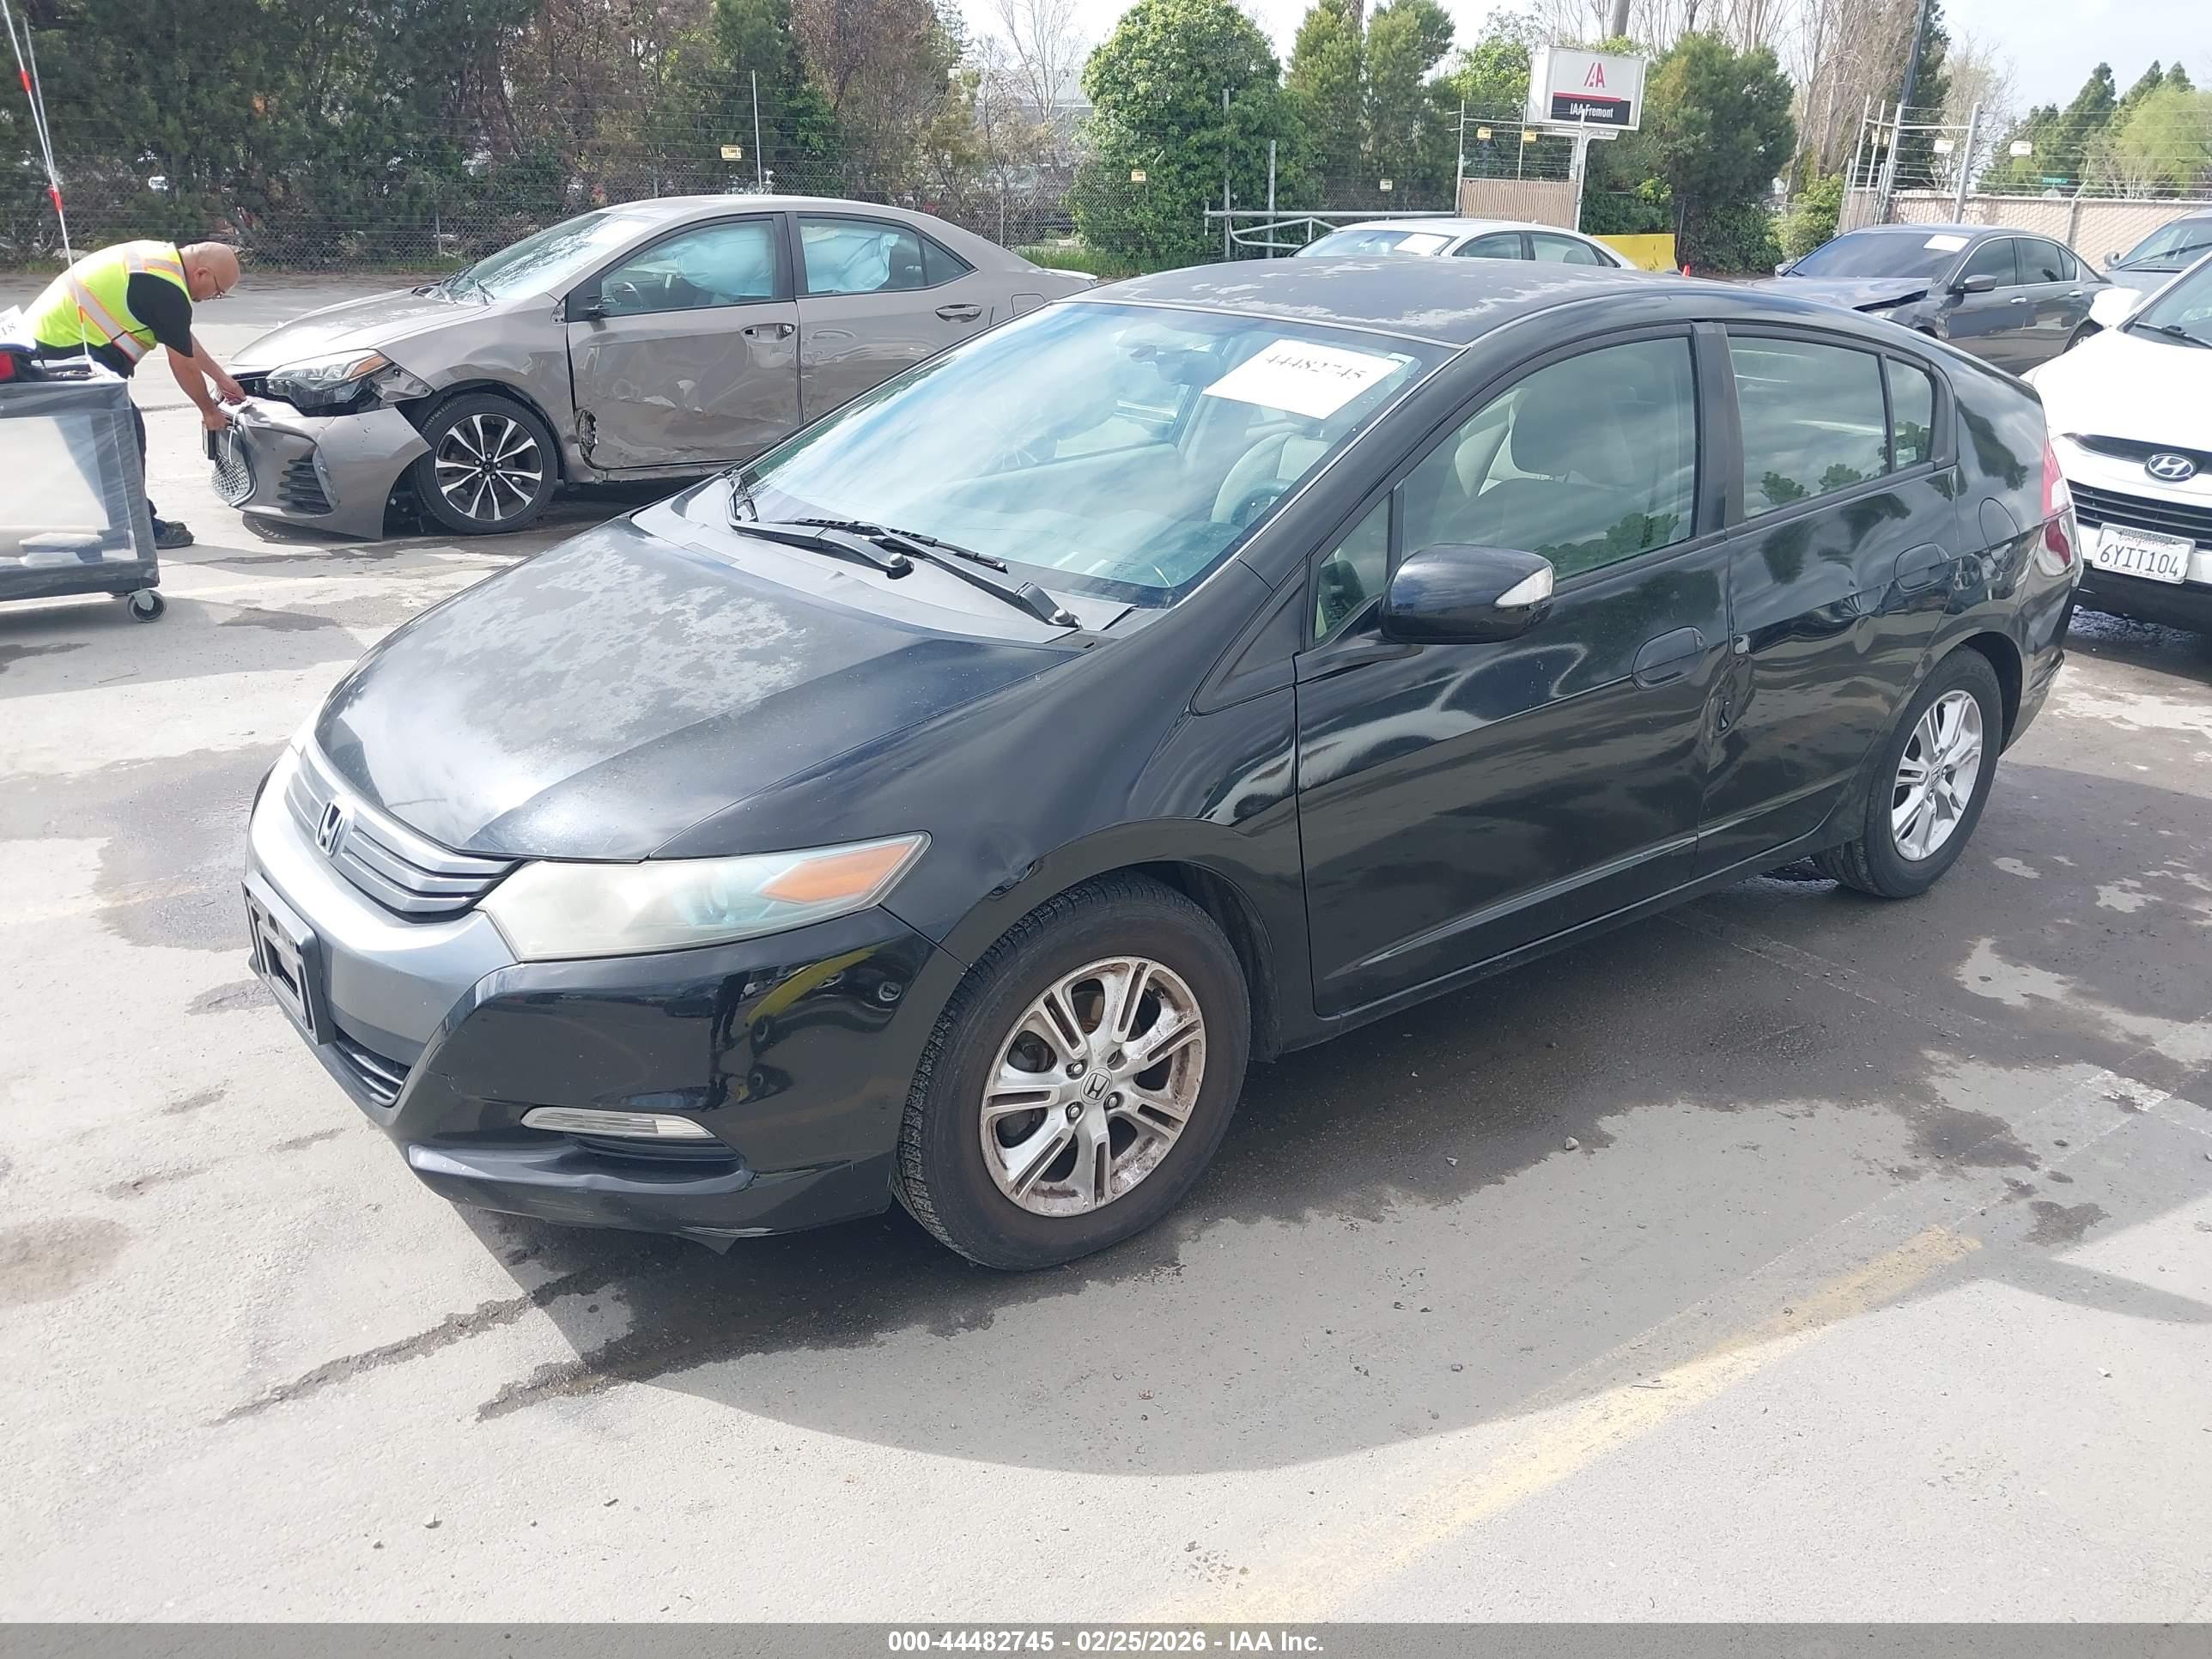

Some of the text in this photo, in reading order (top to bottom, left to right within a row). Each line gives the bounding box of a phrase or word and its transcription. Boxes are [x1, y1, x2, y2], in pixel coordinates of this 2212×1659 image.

[1570, 102, 1614, 118] IAA Fremont
[2100, 544, 2179, 578] 6YIT104
